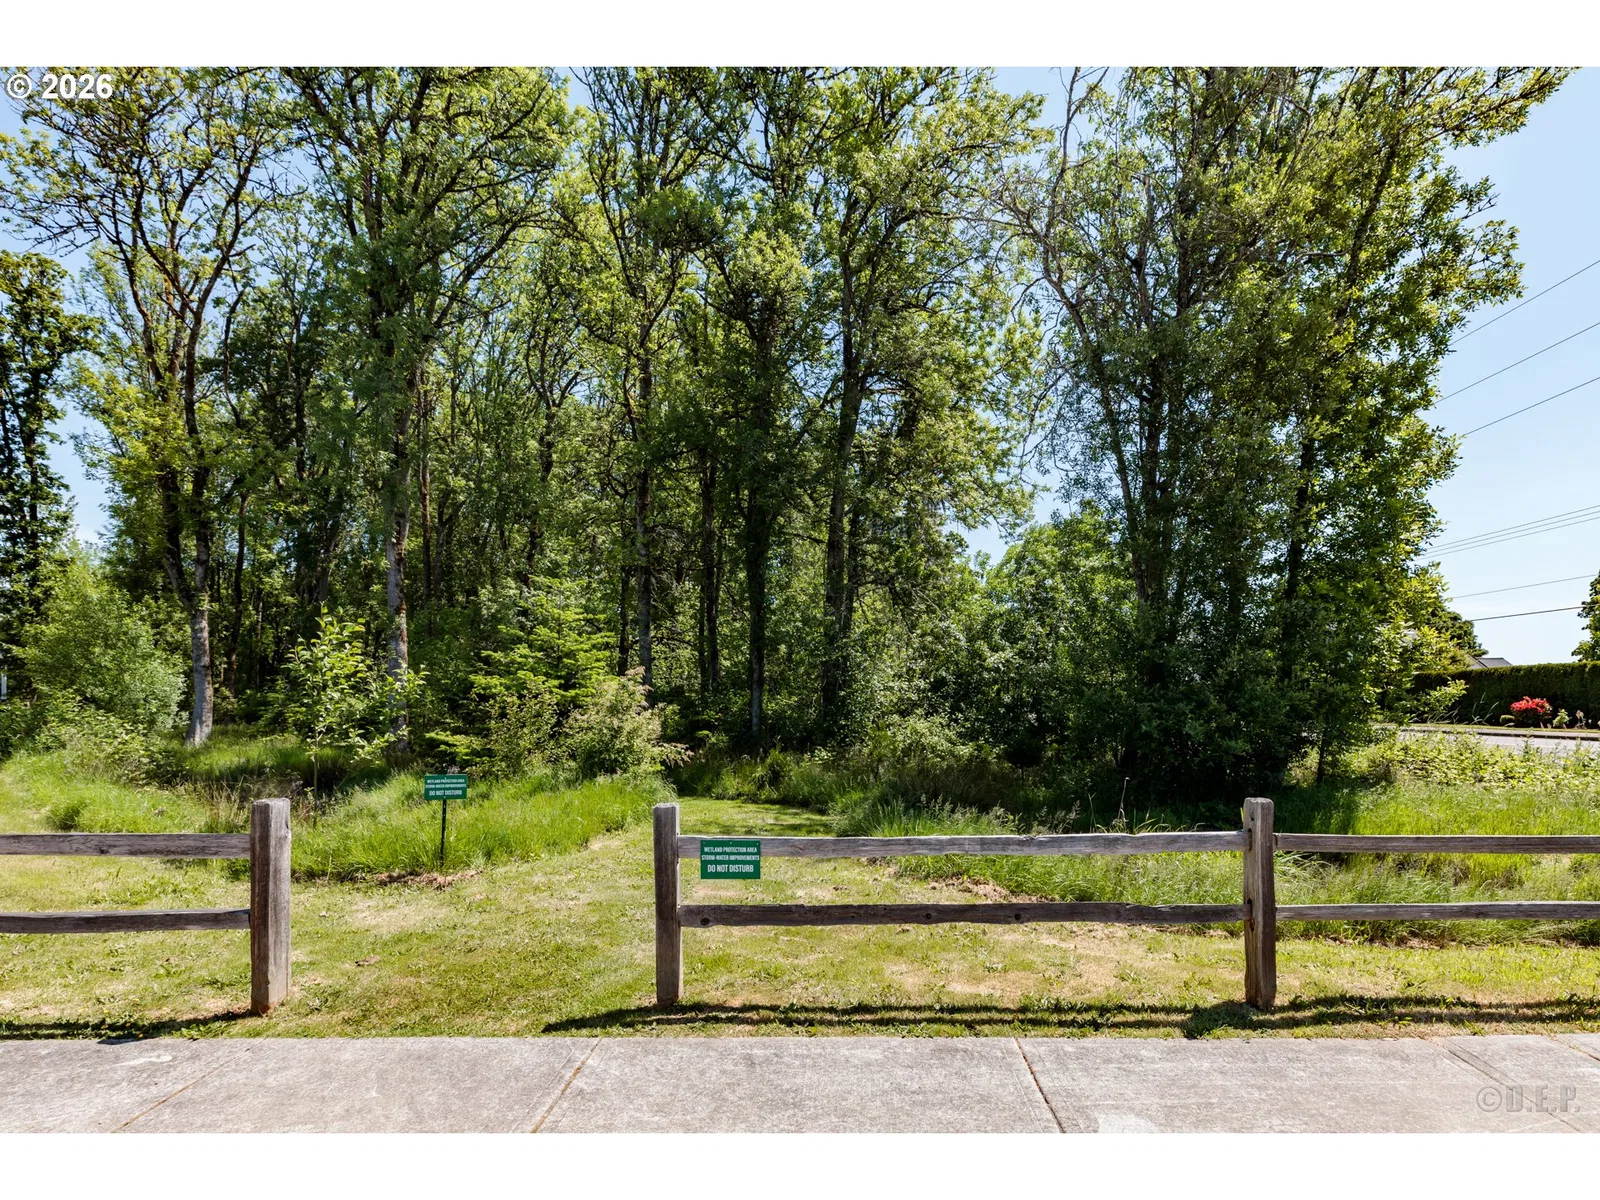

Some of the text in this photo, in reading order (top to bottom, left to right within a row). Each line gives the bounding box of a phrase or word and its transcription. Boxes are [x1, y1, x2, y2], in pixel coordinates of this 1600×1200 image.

[707, 864, 754, 873] DO NOT DISTURB
